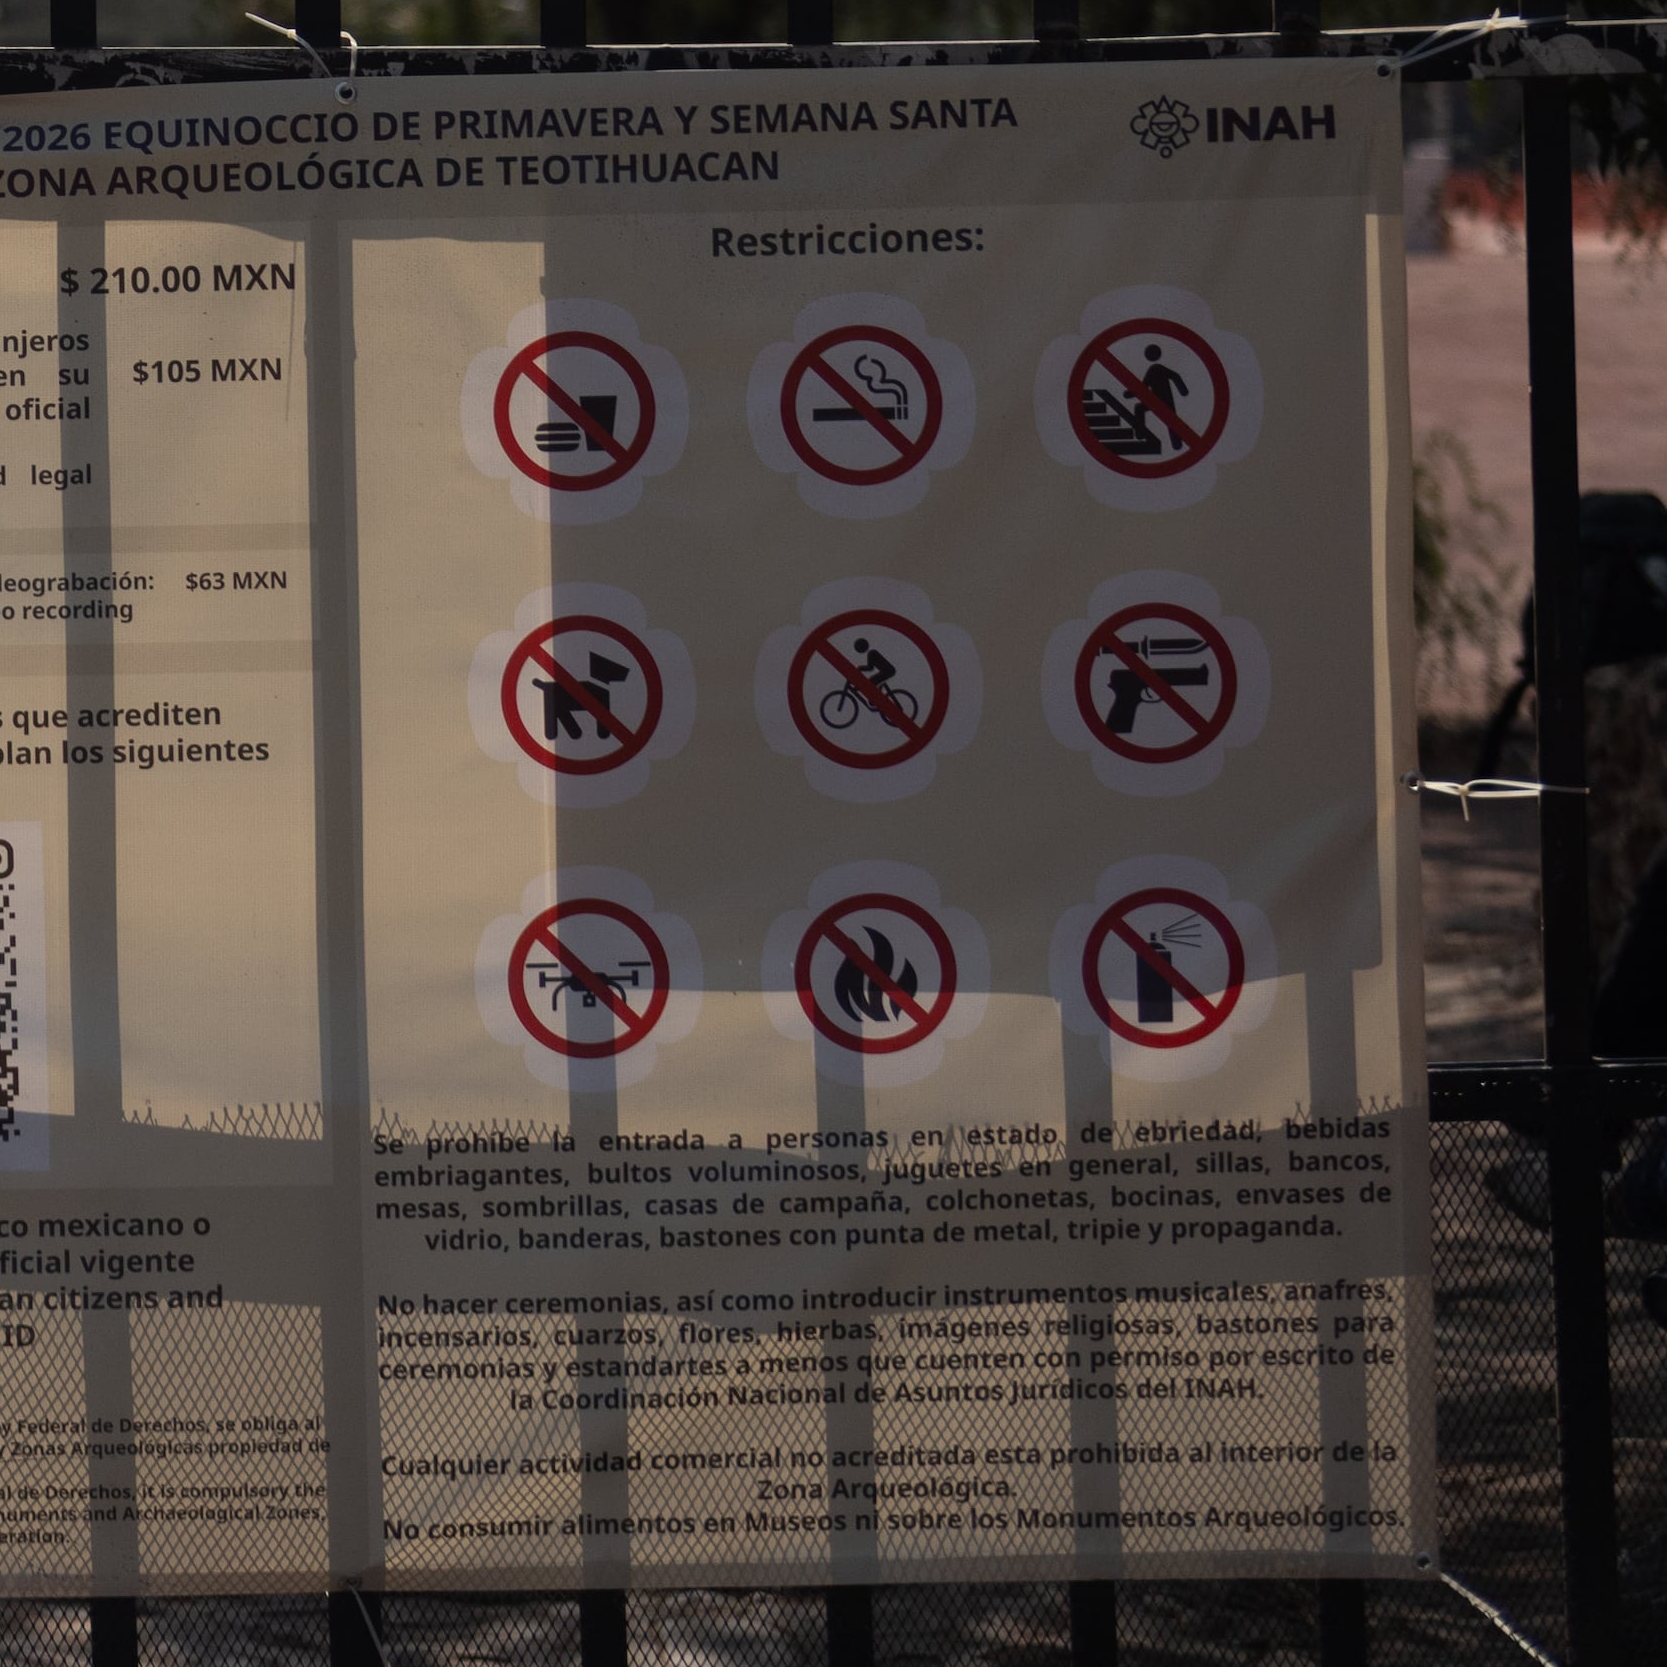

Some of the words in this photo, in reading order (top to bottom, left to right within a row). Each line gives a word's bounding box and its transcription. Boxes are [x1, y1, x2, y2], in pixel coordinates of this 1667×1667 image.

[3, 123, 91, 152] 2026
[105, 112, 358, 152] EQUINOCCIO
[373, 111, 420, 141] DE
[435, 106, 663, 140] PRIMAVERA
[674, 106, 698, 135] Y
[710, 101, 876, 134] SEMANA
[890, 98, 1016, 130] SANTA
[1206, 105, 1336, 143] INAH
[107, 153, 423, 200] ARQUEOLÓGICA
[436, 157, 484, 187] DE
[495, 151, 778, 186] TEOTIHUACAN
[712, 224, 983, 257] Restricciones:
[61, 267, 79, 297] $
[91, 265, 201, 294] 210.00
[213, 263, 295, 291] MXN
[59, 368, 89, 385] su
[133, 360, 201, 385] $105
[212, 358, 281, 382] MXN
[6, 396, 90, 421] oficial
[31, 463, 91, 491] legal
[186, 572, 225, 591] $63
[233, 571, 287, 590] MXN
[23, 600, 134, 624] recording
[13, 710, 68, 735] que
[78, 702, 220, 727] acrediten
[63, 740, 103, 764] los
[113, 738, 269, 770] siguientes
[373, 1133, 403, 1155] Se
[553, 1130, 575, 1152] la
[599, 1129, 704, 1152] entrada
[728, 1133, 742, 1150] a
[767, 1130, 888, 1156] personas
[911, 1129, 944, 1147] en
[967, 1125, 1057, 1146] estado
[1081, 1122, 1112, 1143] de
[1134, 1120, 1263, 1146] ebriedad,
[1285, 1117, 1390, 1139] bebidas
[375, 1163, 570, 1192] embriagantes,
[588, 1162, 671, 1184] bultos
[688, 1160, 867, 1183] voluminosos,
[883, 1155, 1002, 1185] juguetes
[1019, 1158, 1051, 1177] en
[1069, 1154, 1178, 1182] general,
[1196, 1151, 1270, 1175] sillas,
[1289, 1150, 1390, 1173] bancos,
[376, 1202, 466, 1221] mesas,
[483, 1195, 629, 1219] sombrillas,
[645, 1198, 717, 1215] casas
[733, 1193, 764, 1214] de
[780, 1189, 910, 1219] campaña,
[926, 1185, 1095, 1210] colchonetas,
[1111, 1185, 1220, 1208] bocinas,
[1237, 1187, 1344, 1205] envases
[1359, 1181, 1391, 1203] de
[39, 1212, 183, 1237] mexicano
[193, 1217, 210, 1235] o
[425, 1228, 509, 1253] vidrio,
[519, 1227, 650, 1251] banderas,
[660, 1226, 781, 1248] bastones
[789, 1229, 836, 1245] con
[846, 1225, 924, 1251] punta
[933, 1221, 965, 1243] de
[974, 1218, 1058, 1243] metal,
[1067, 1218, 1140, 1246] tripie
[1148, 1223, 1163, 1245] y
[1172, 1214, 1342, 1245] propaganda.
[80, 1249, 194, 1280] vigente
[45, 1286, 158, 1310] citizens
[169, 1284, 223, 1309] and
[379, 1296, 414, 1315] No
[423, 1293, 498, 1314] hacer
[505, 1292, 668, 1318] ceremonias,
[677, 1289, 714, 1312] así
[721, 1295, 794, 1310] como
[803, 1287, 936, 1309] introducir
[945, 1285, 1127, 1307] instrumentos
[1135, 1281, 1274, 1304] musicales,
[1284, 1278, 1392, 1303] anafres,
[3, 1324, 35, 1347] ID
[757, 1480, 823, 1500] Zona
[831, 1476, 1017, 1504] Arqueológica.
